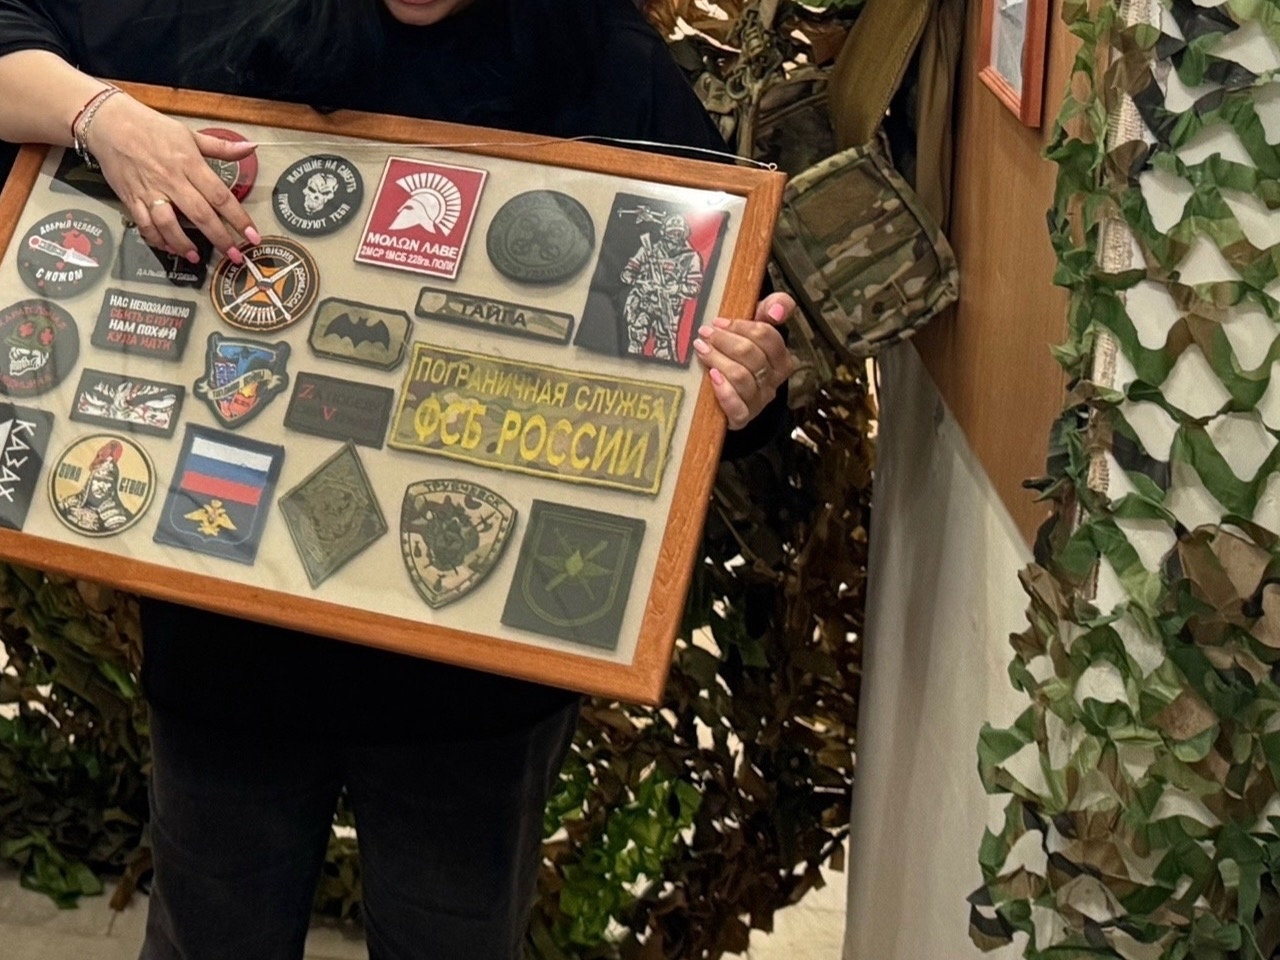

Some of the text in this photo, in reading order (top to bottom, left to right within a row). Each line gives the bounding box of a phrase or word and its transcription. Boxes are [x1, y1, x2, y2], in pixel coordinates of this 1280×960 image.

[286, 159, 357, 193] ИДУЩИЕ НА СМЕРТЬ
[278, 193, 351, 230] ПРИВЕТСТВУЮТ ТЕБЯ
[40, 220, 72, 236] ДОБРЫЙ
[35, 267, 84, 282] С НОЖОМ
[223, 266, 239, 296] ДИКАЯ
[252, 246, 295, 263] ДИВИЗИЯ
[109, 294, 191, 319] НАС НЕВОЗМОЖНО
[458, 298, 528, 328] ТАЙГА
[108, 318, 135, 333] НАМ
[415, 355, 666, 422] ПОГРАНИЧНАЯ СЛУЖБА
[413, 393, 651, 479] ФСБ РОССИИ
